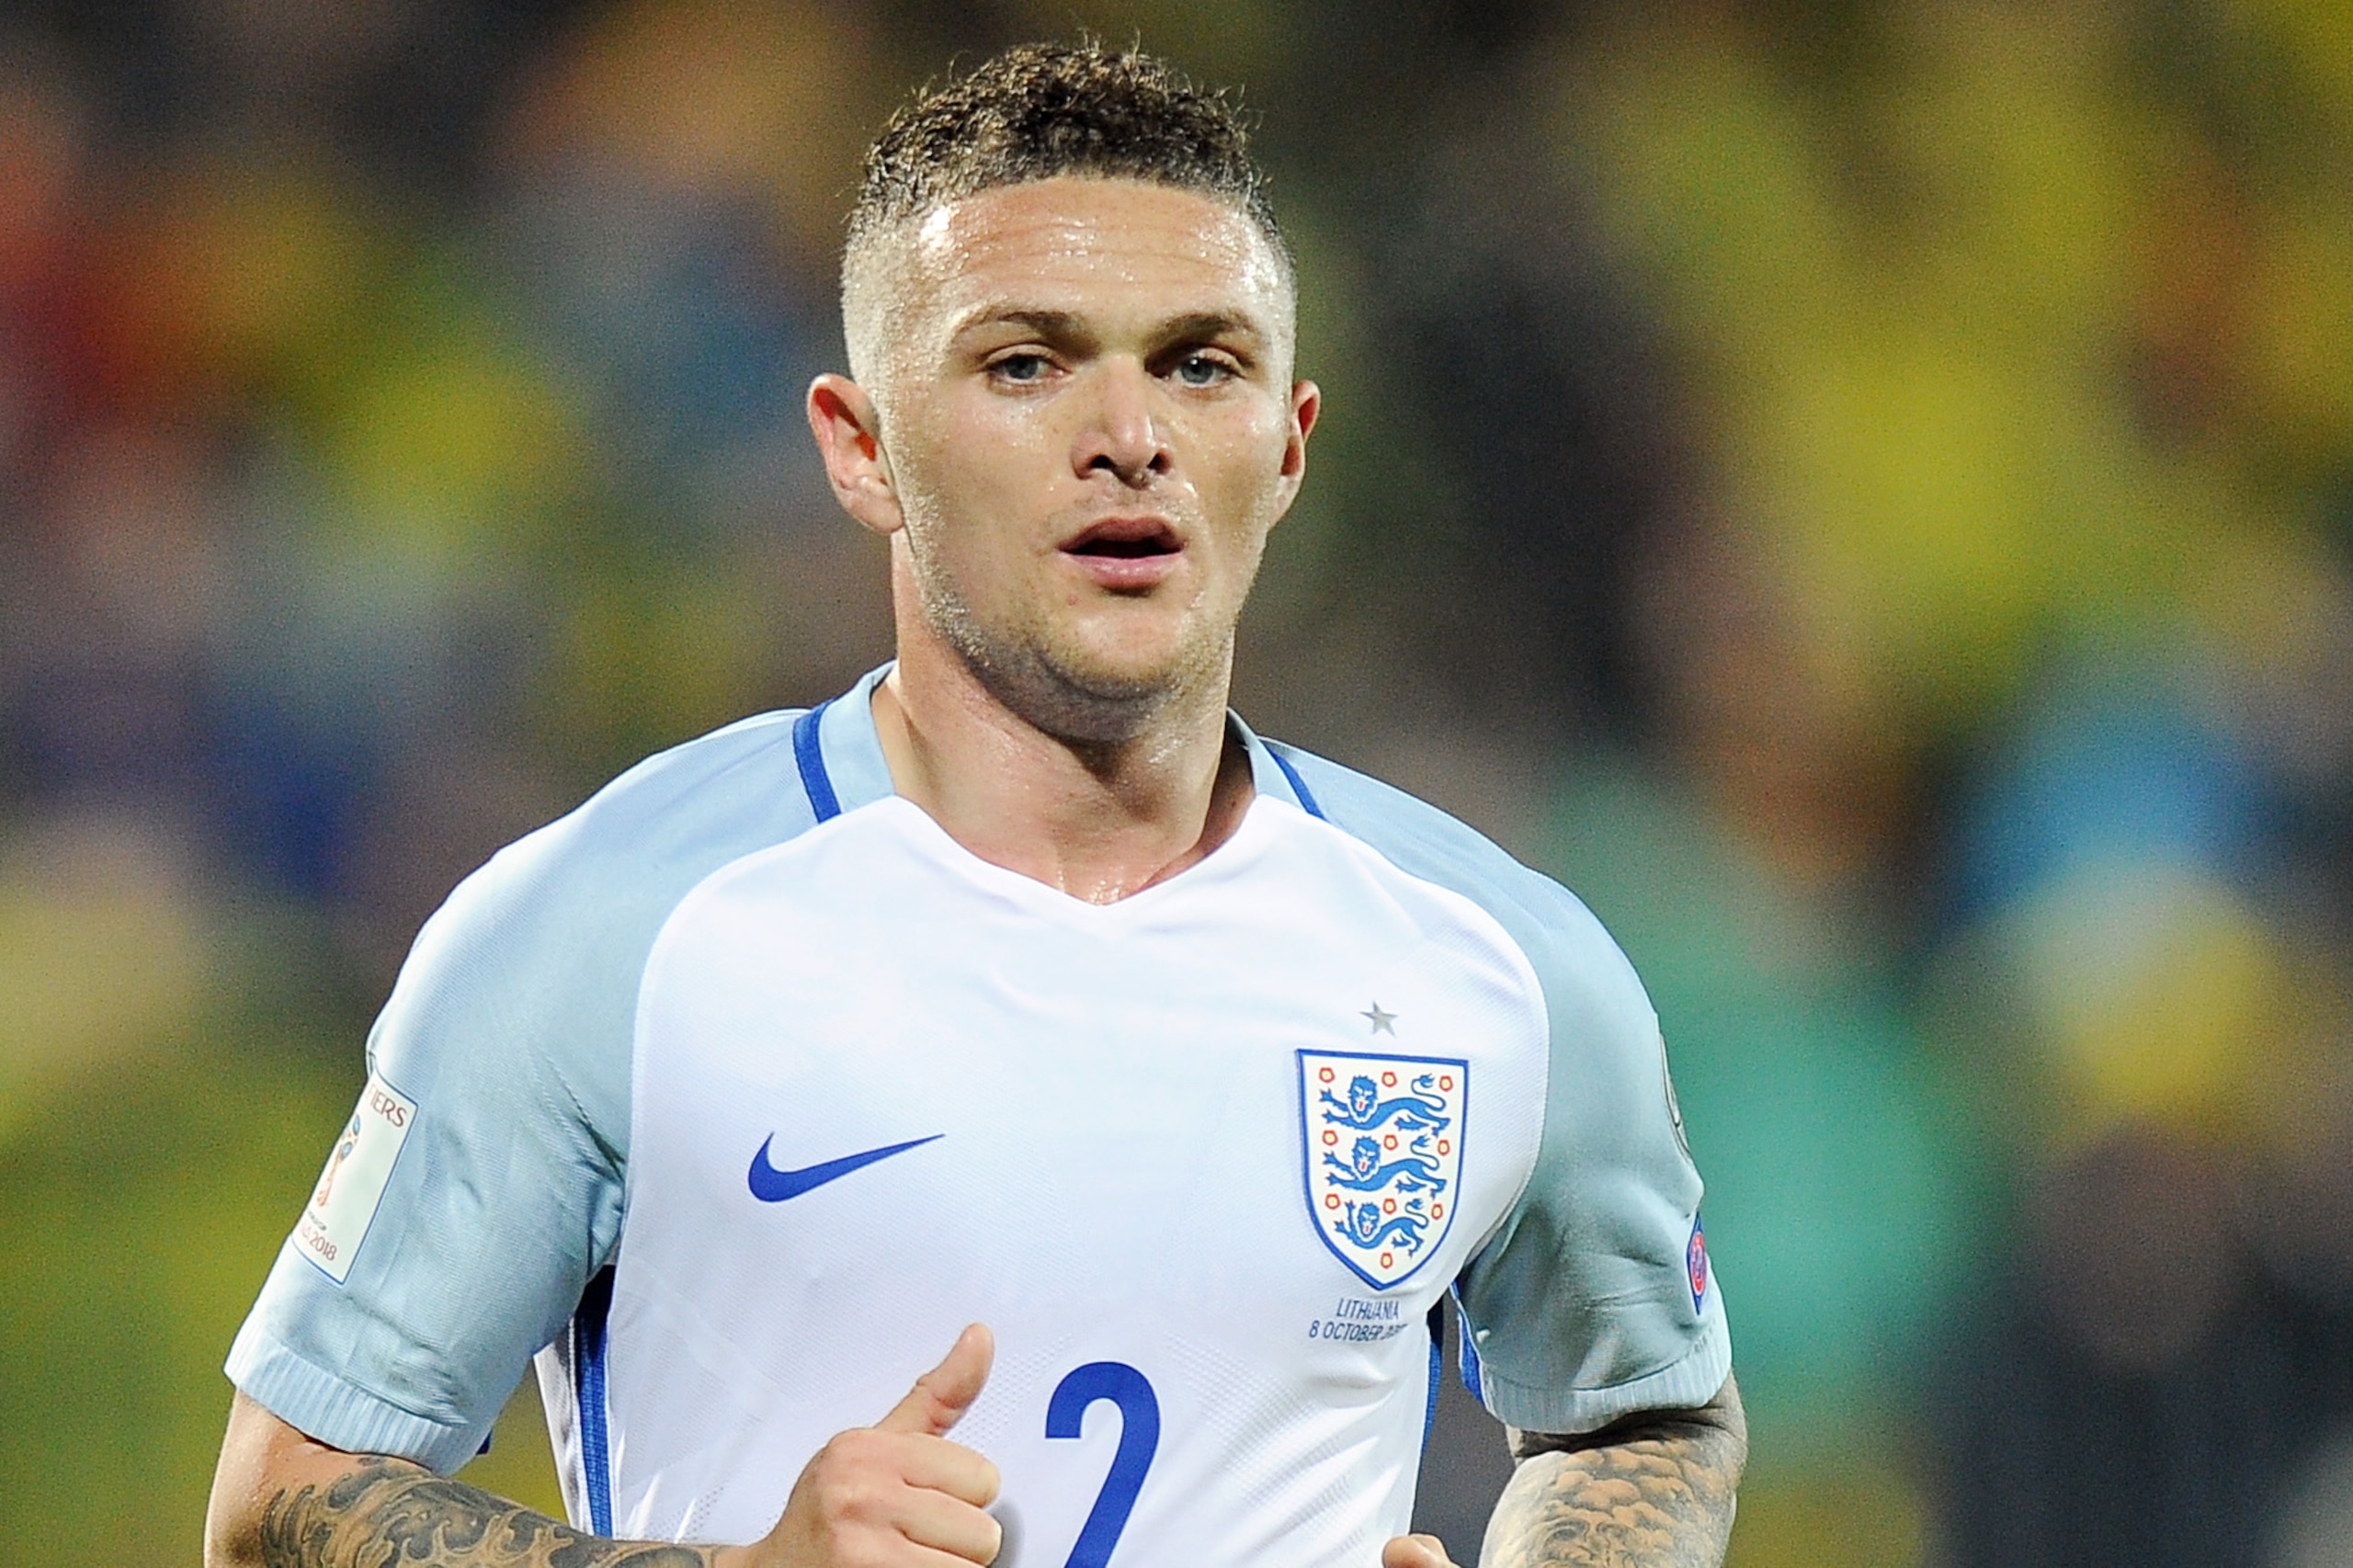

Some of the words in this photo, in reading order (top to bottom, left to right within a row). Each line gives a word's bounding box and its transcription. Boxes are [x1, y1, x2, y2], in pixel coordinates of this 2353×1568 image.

[309, 1231, 337, 1261] 2018
[1336, 1298, 1399, 1320] LITHUANIA
[1309, 1320, 1320, 1338] 8
[1324, 1321, 1383, 1341] OCTOBER
[1045, 1361, 1160, 1568] 2
